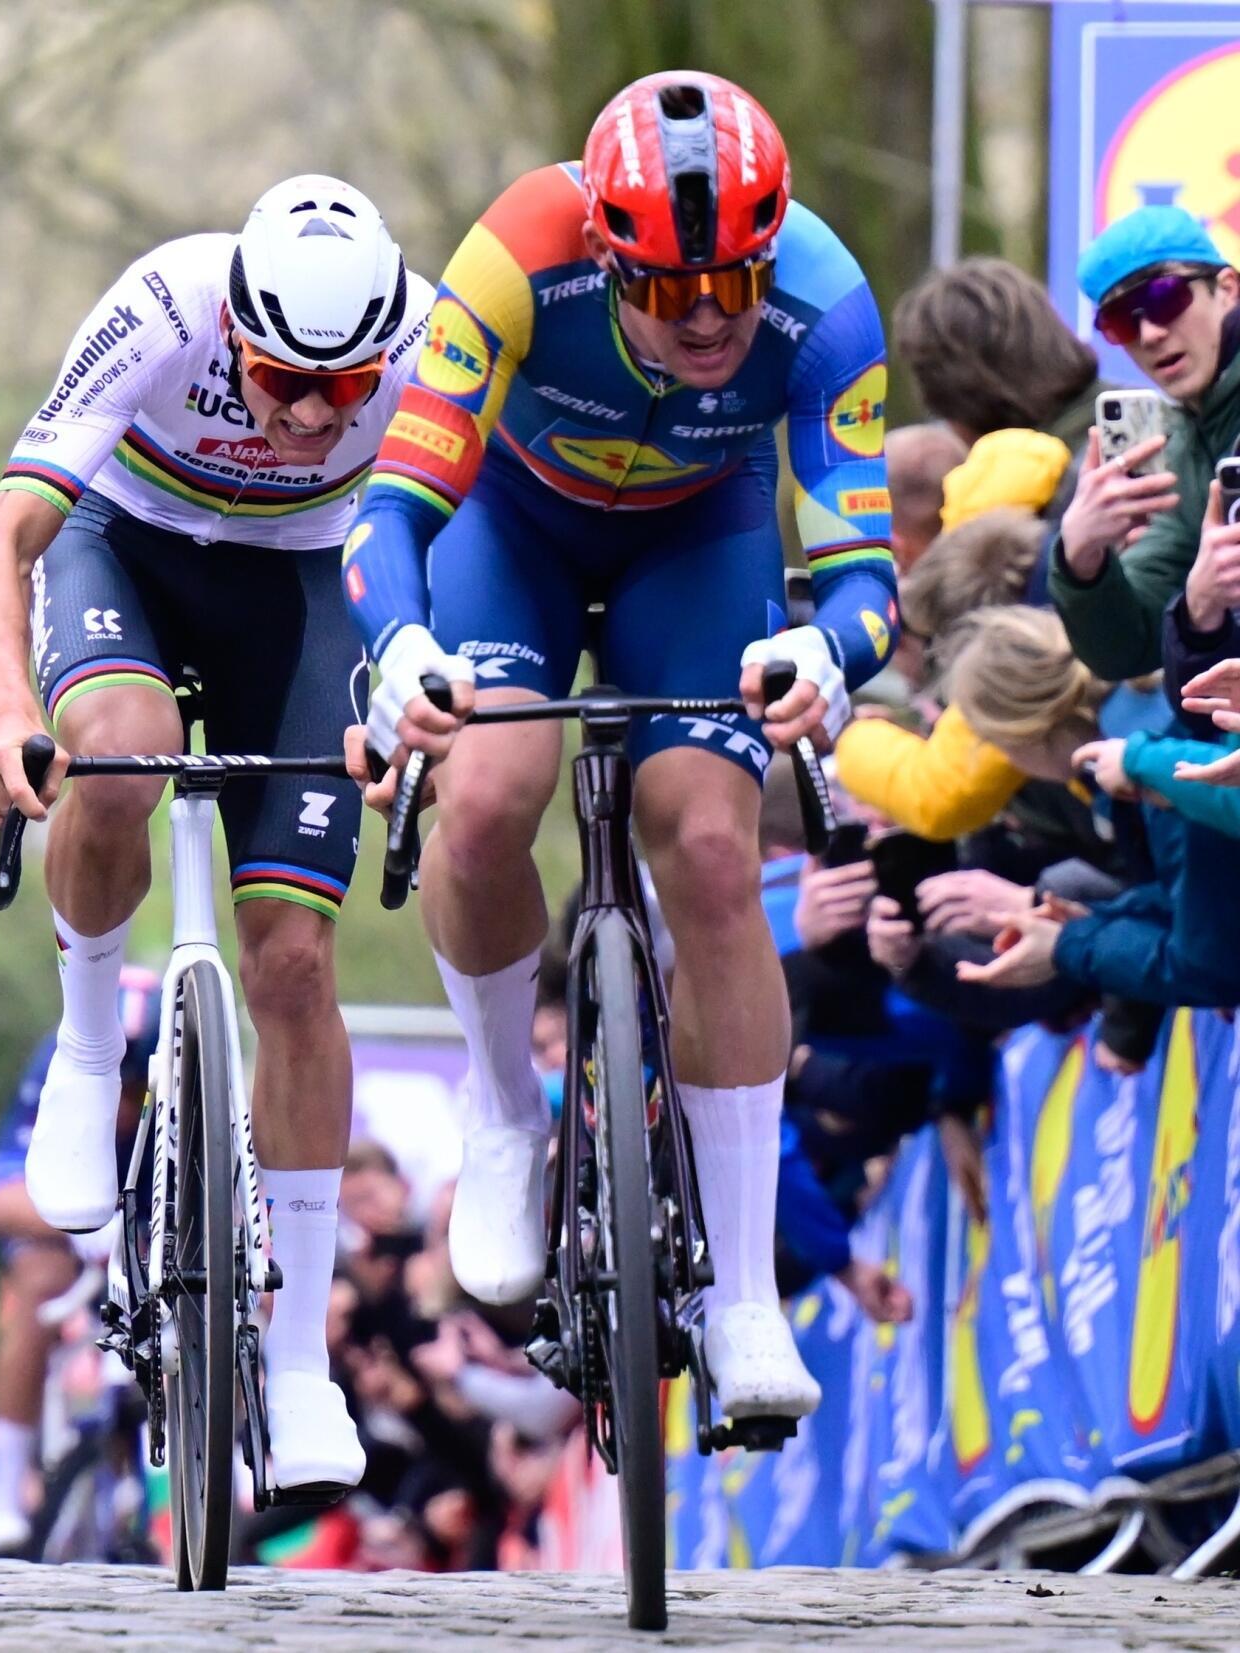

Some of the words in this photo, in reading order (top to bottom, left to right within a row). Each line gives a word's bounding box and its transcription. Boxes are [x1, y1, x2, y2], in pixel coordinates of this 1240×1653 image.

[616, 99, 646, 189] TREK
[538, 271, 607, 307] TREK
[299, 327, 346, 339] CANYON
[387, 312, 431, 365] BRUST
[759, 299, 808, 342] REK
[37, 304, 144, 423] deceuninck
[78, 358, 129, 407] WINDOWS
[197, 388, 256, 430] UCI
[670, 423, 765, 439] SRAM
[173, 449, 326, 485] deceuninck
[212, 442, 281, 461] Alpe
[457, 640, 547, 667] Santini
[678, 716, 770, 773] TR
[298, 826, 327, 839] ZWIFT
